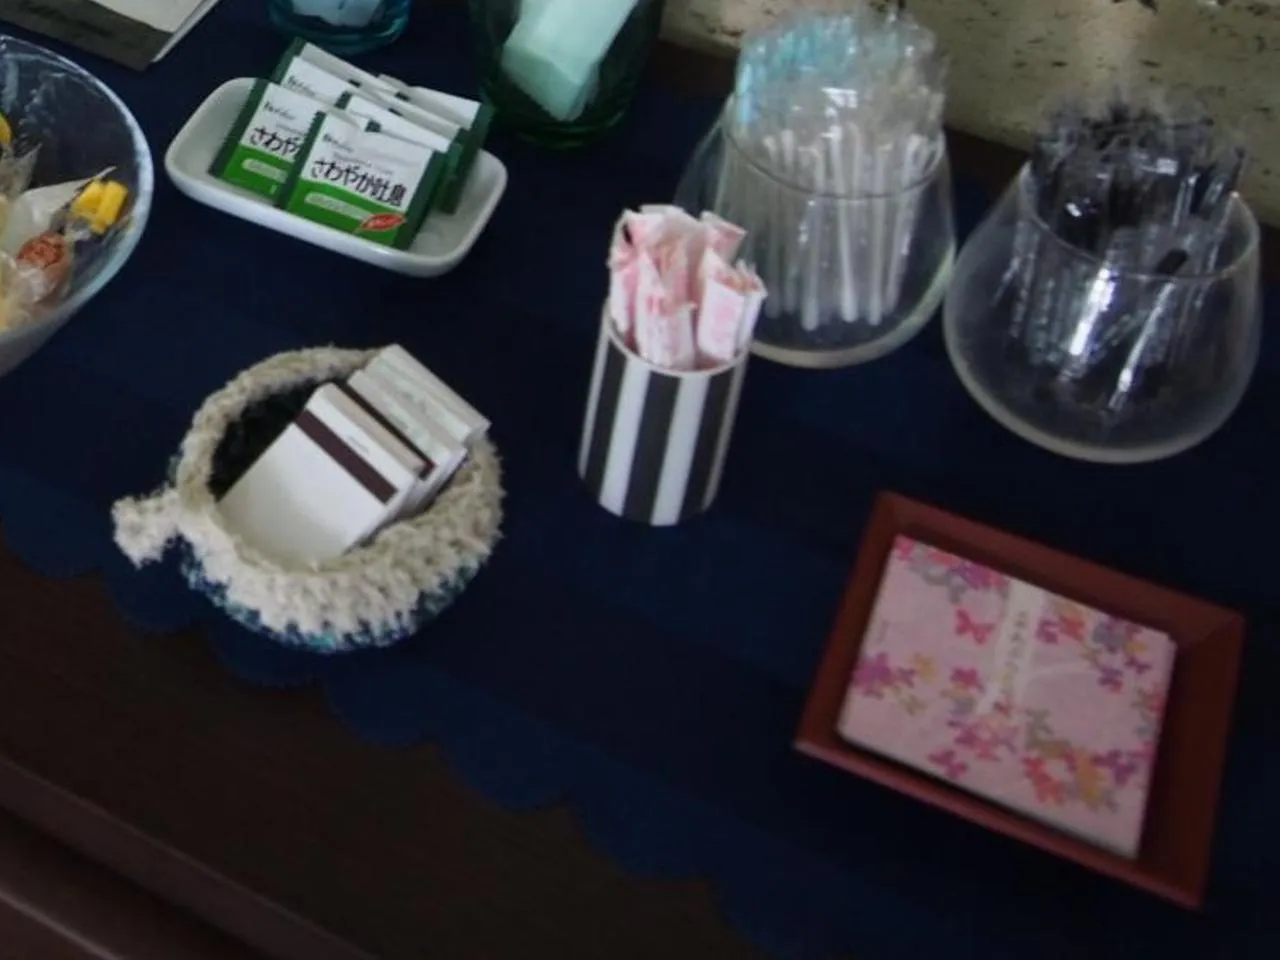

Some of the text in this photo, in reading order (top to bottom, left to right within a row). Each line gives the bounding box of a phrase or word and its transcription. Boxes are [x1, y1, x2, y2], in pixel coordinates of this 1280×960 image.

[308, 156, 410, 208] さわやか吐息
